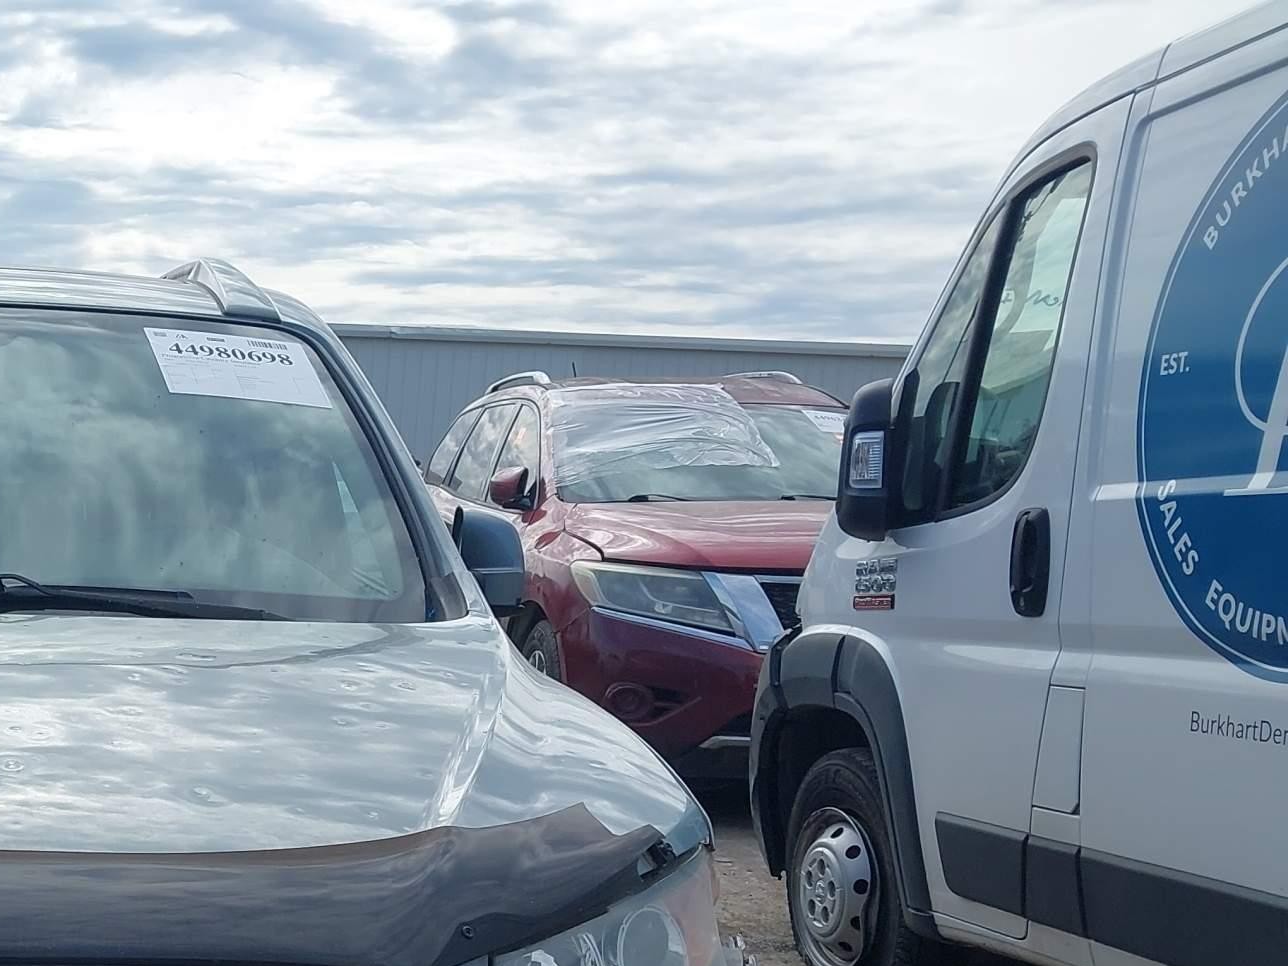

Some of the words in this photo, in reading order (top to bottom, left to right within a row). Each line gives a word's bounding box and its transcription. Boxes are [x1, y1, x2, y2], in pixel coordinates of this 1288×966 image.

[168, 342, 294, 366] 44980698
[1159, 351, 1190, 376] EST.
[1157, 479, 1199, 576] SALES
